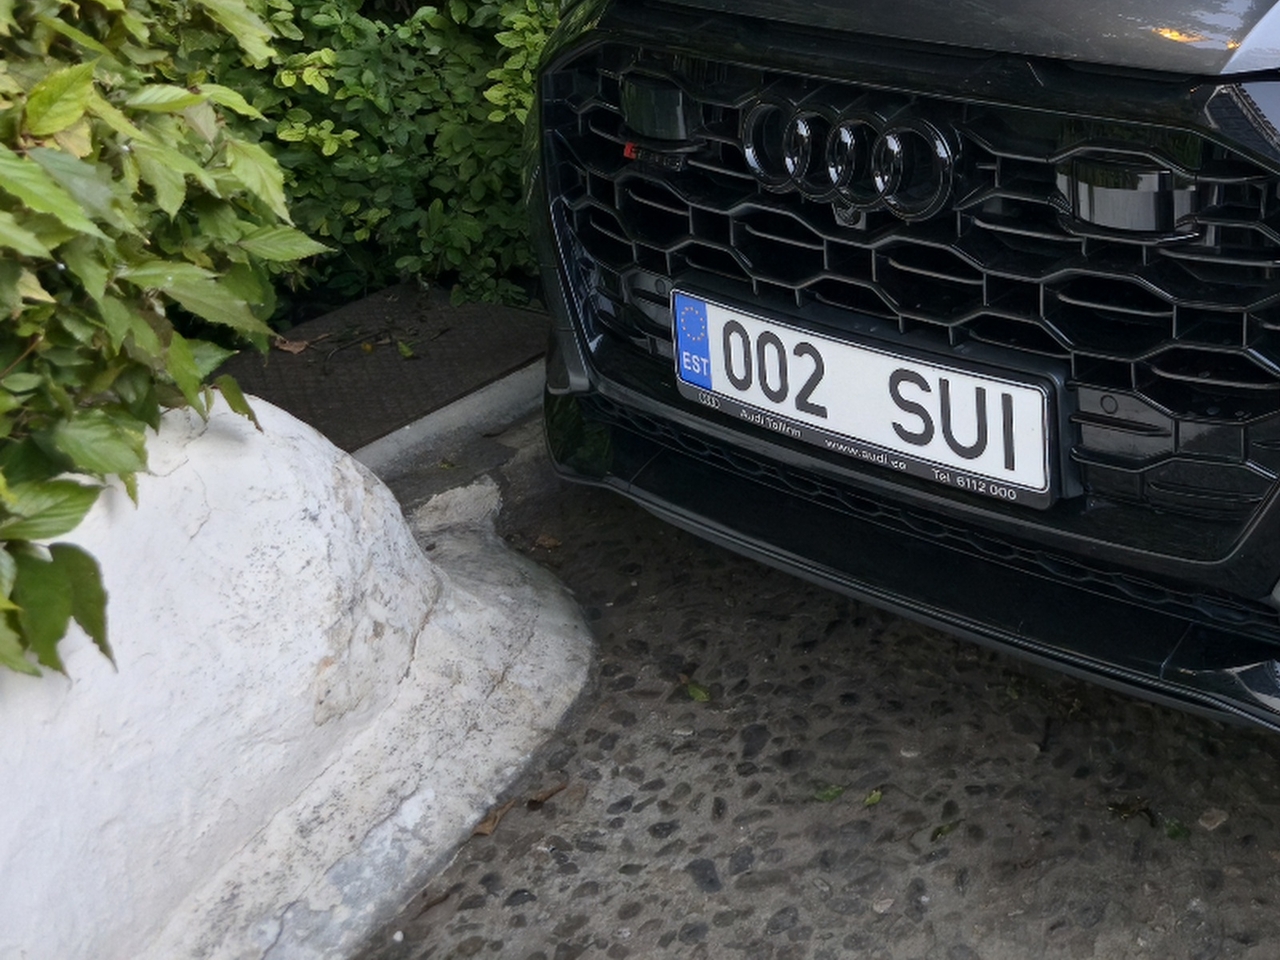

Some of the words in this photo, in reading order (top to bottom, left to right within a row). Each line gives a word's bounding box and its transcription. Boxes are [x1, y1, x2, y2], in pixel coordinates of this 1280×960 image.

[682, 351, 709, 375] EST
[723, 319, 828, 419] 002
[889, 368, 1015, 471] SUI
[956, 476, 986, 493] 6112
[989, 484, 1017, 500] 000
